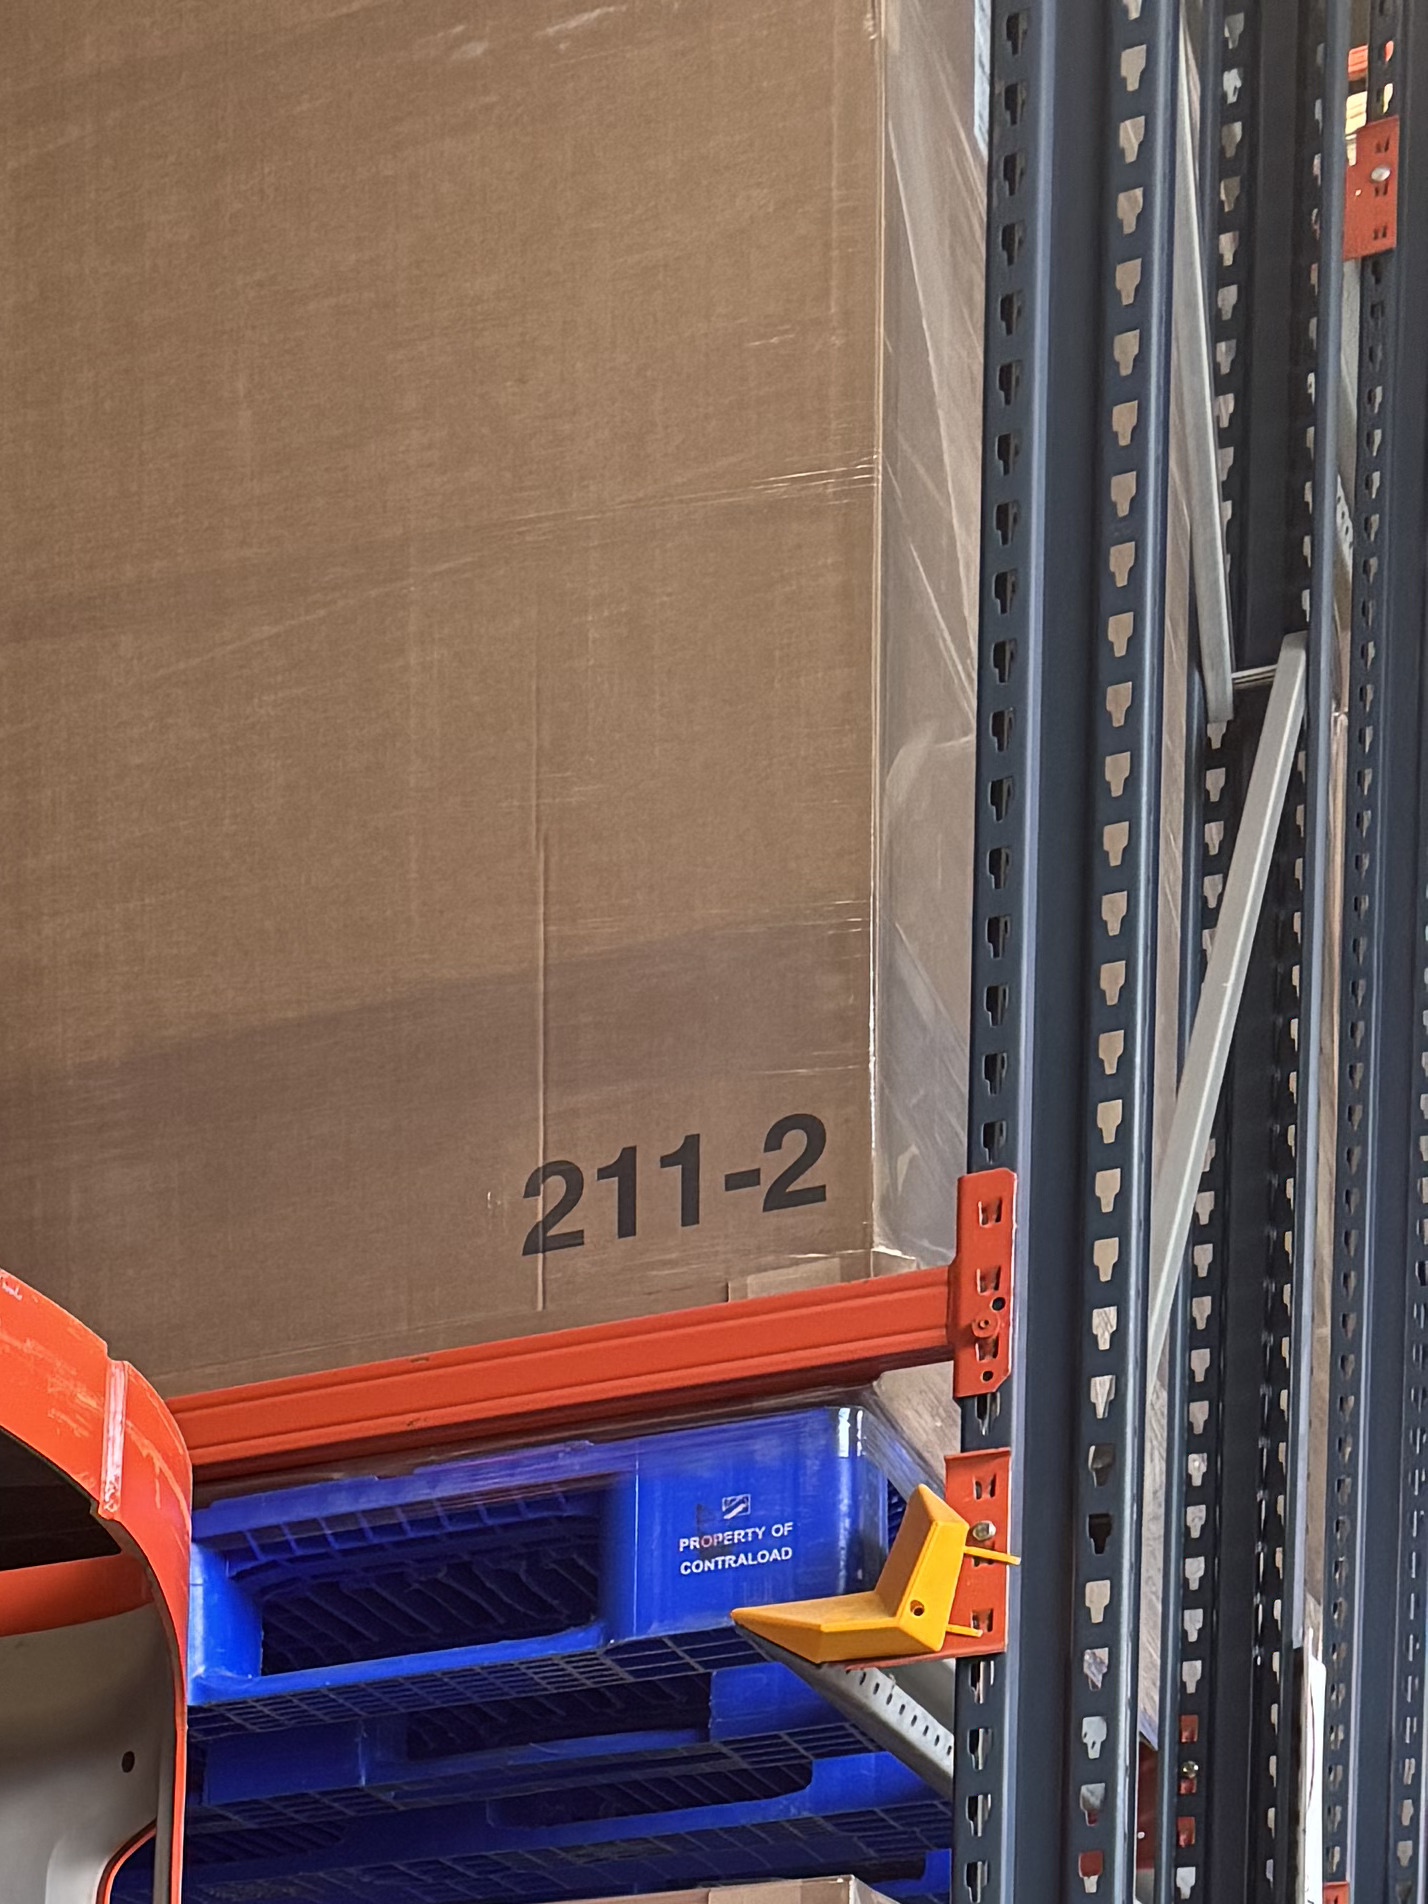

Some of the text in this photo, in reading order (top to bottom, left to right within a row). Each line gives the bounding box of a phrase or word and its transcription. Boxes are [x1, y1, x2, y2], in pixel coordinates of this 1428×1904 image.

[522, 1112, 827, 1257] 211-2
[679, 1522, 794, 1552] PROPERTY OF
[680, 1546, 792, 1575] CONTRALOAD
